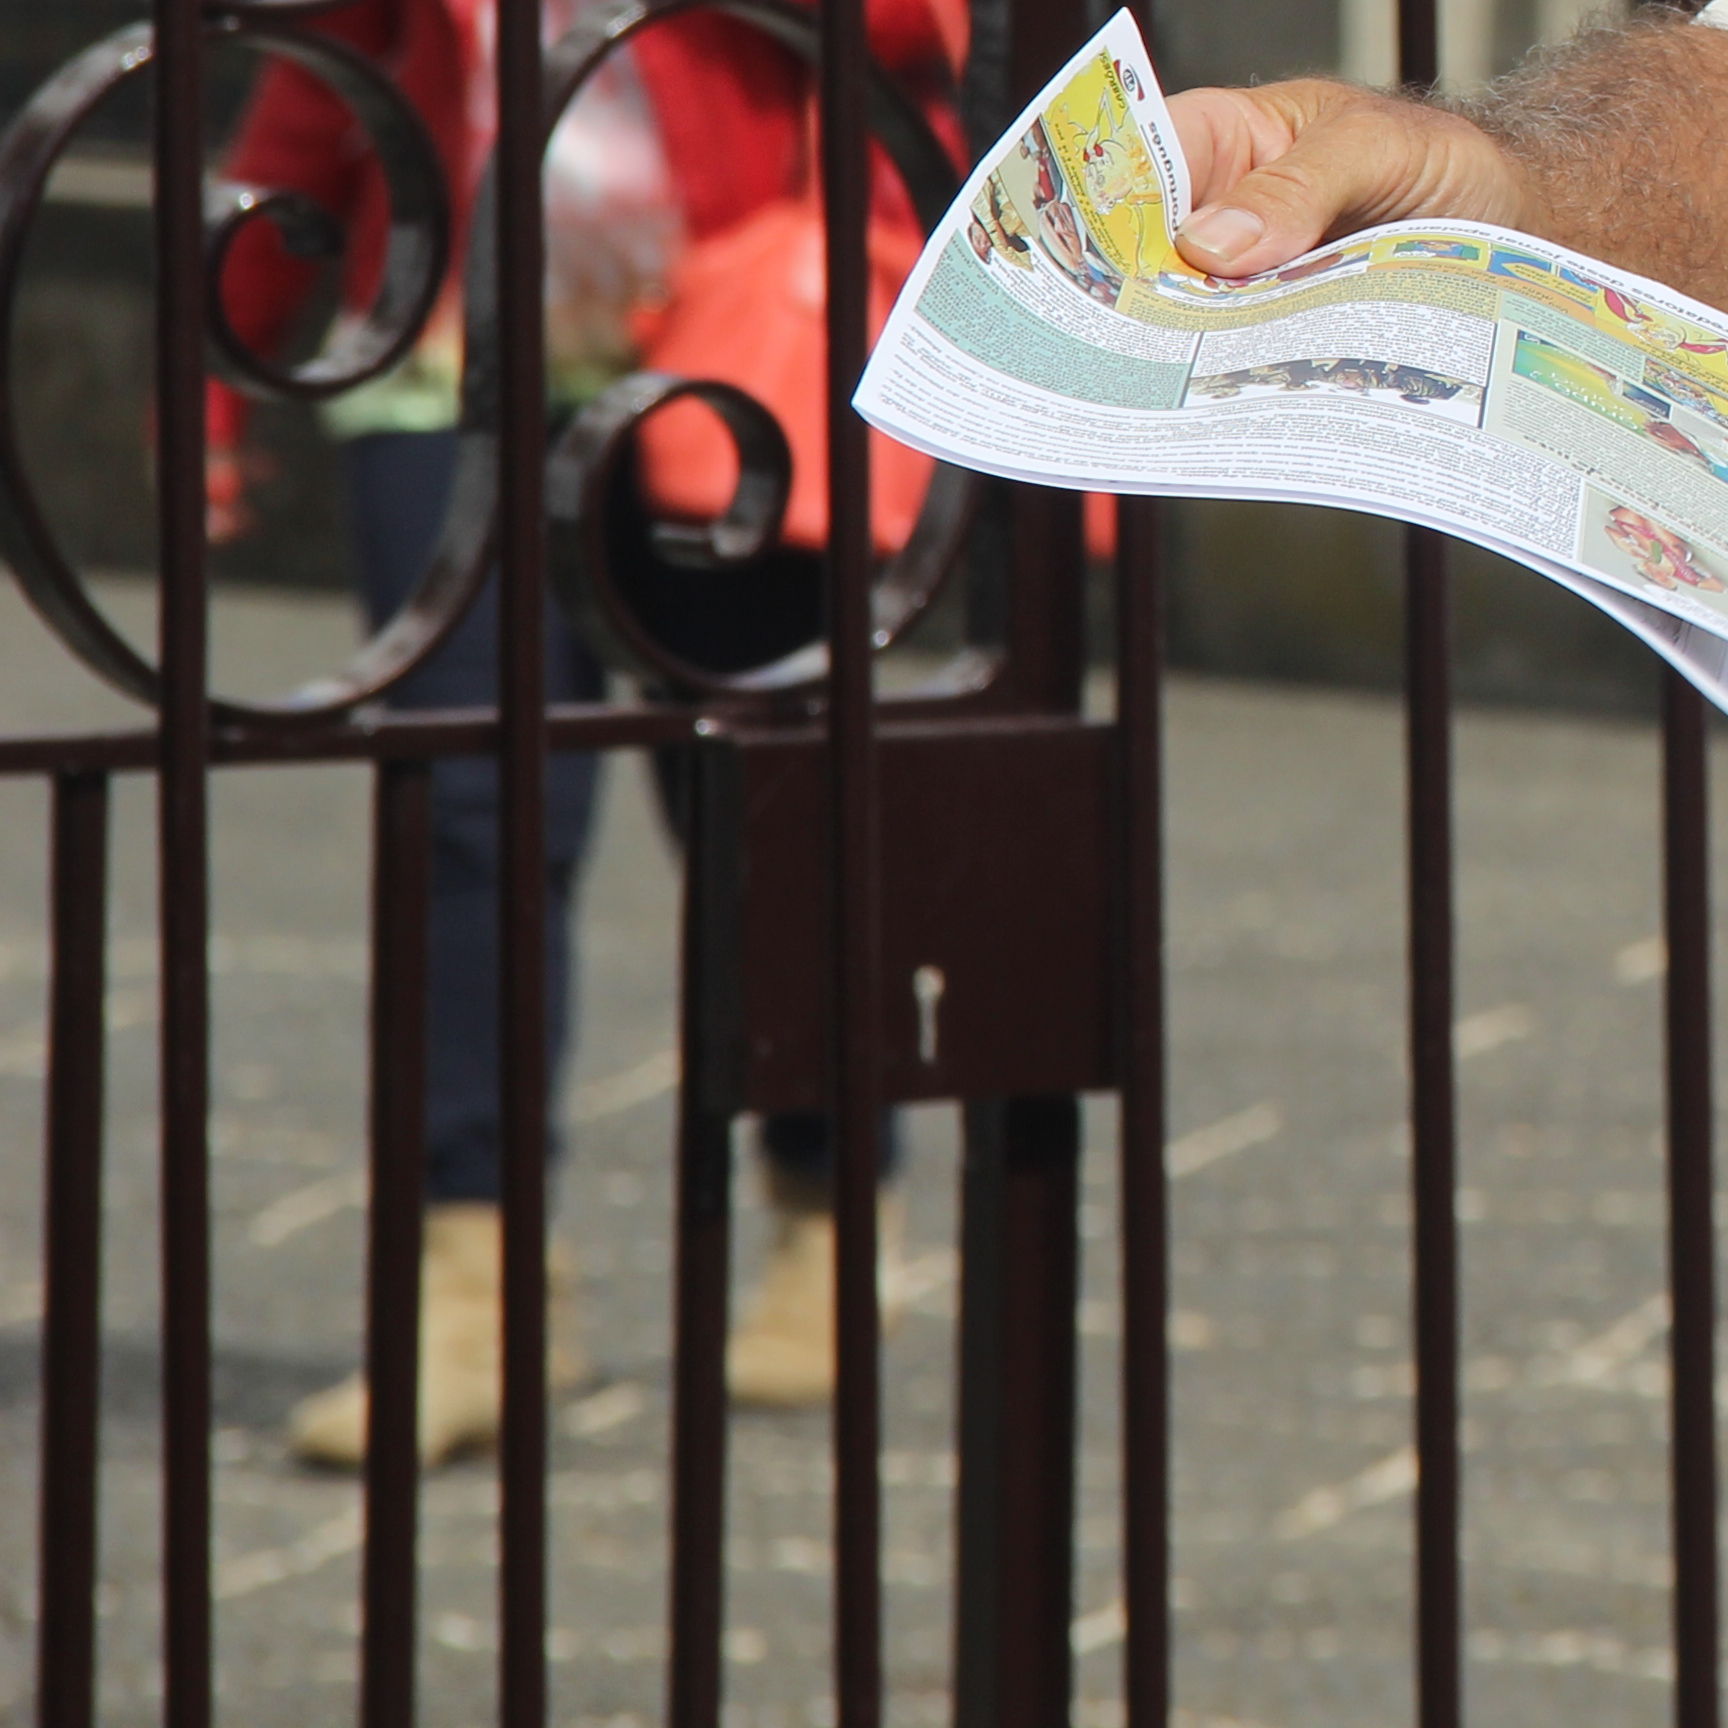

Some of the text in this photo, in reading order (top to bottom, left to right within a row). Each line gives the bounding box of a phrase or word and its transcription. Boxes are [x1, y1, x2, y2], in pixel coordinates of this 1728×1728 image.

[1122, 69, 1138, 90] PTP
[1144, 120, 1184, 233] Português
[1496, 234, 1564, 261] jornal
[1565, 259, 1625, 288] deste
